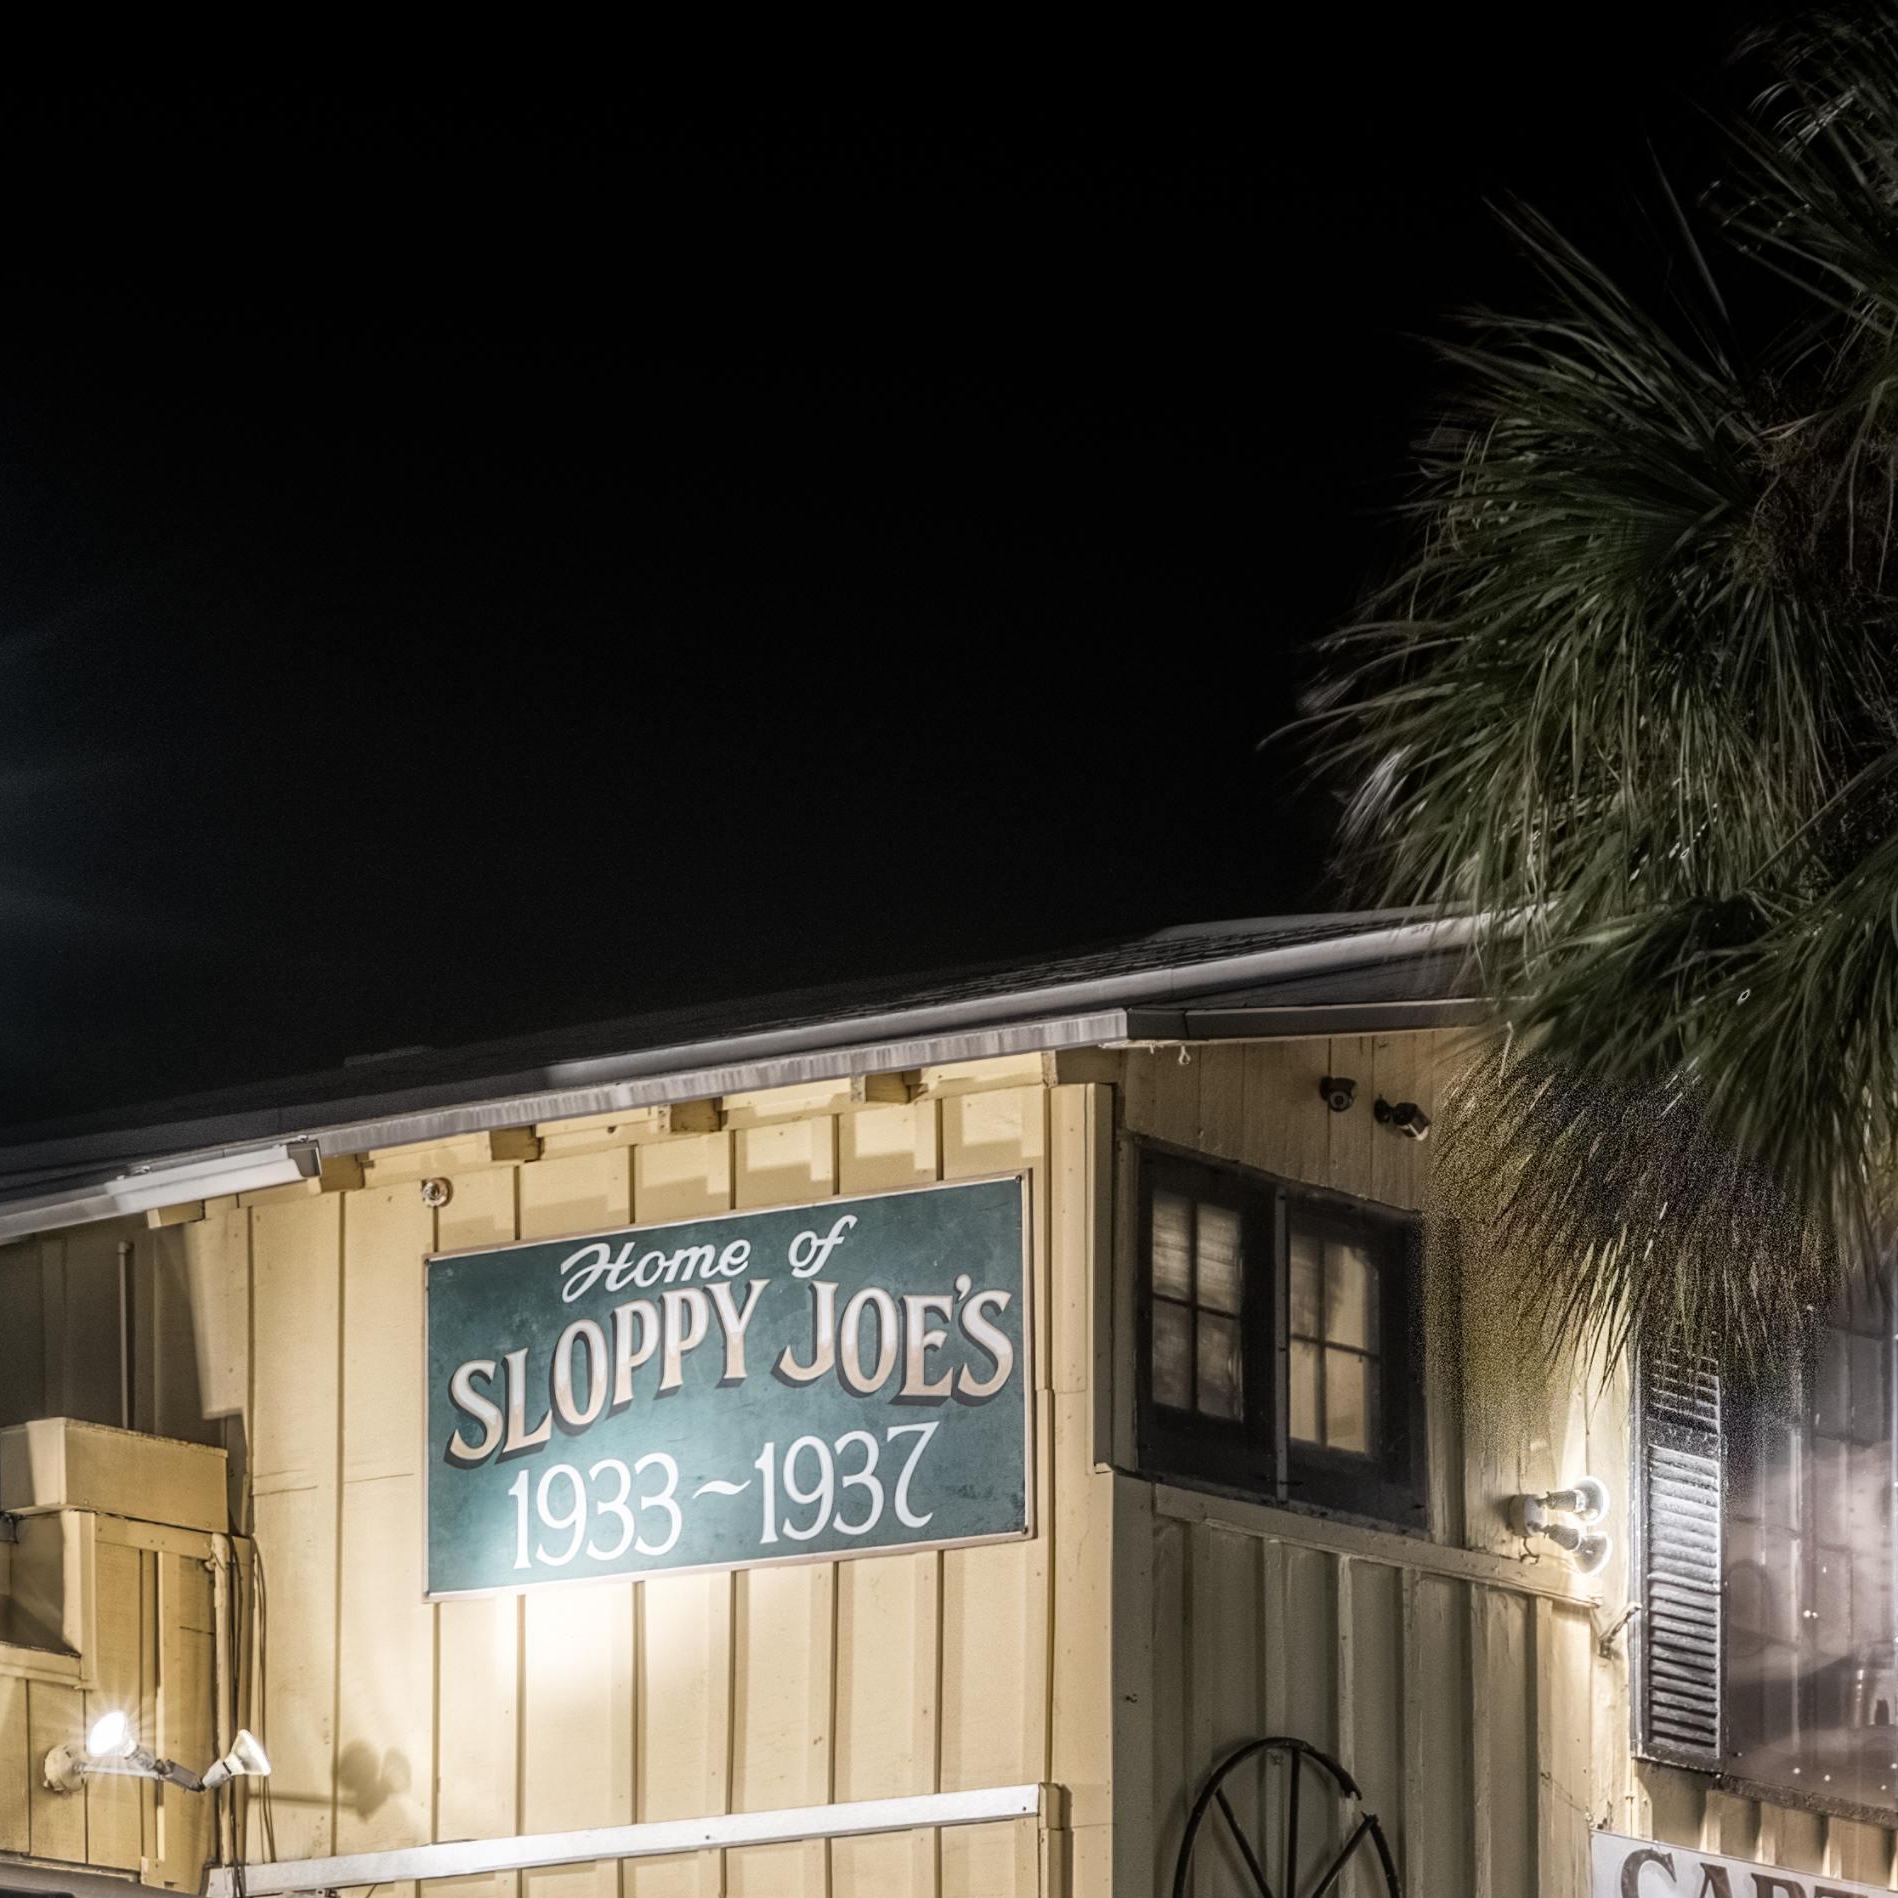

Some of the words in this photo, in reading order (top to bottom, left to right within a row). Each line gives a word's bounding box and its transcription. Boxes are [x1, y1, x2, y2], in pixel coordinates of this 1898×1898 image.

[559, 1238, 752, 1304] Home
[788, 1214, 859, 1279] of
[446, 1279, 773, 1464] SLOPPY
[777, 1274, 1015, 1402] JOE'S
